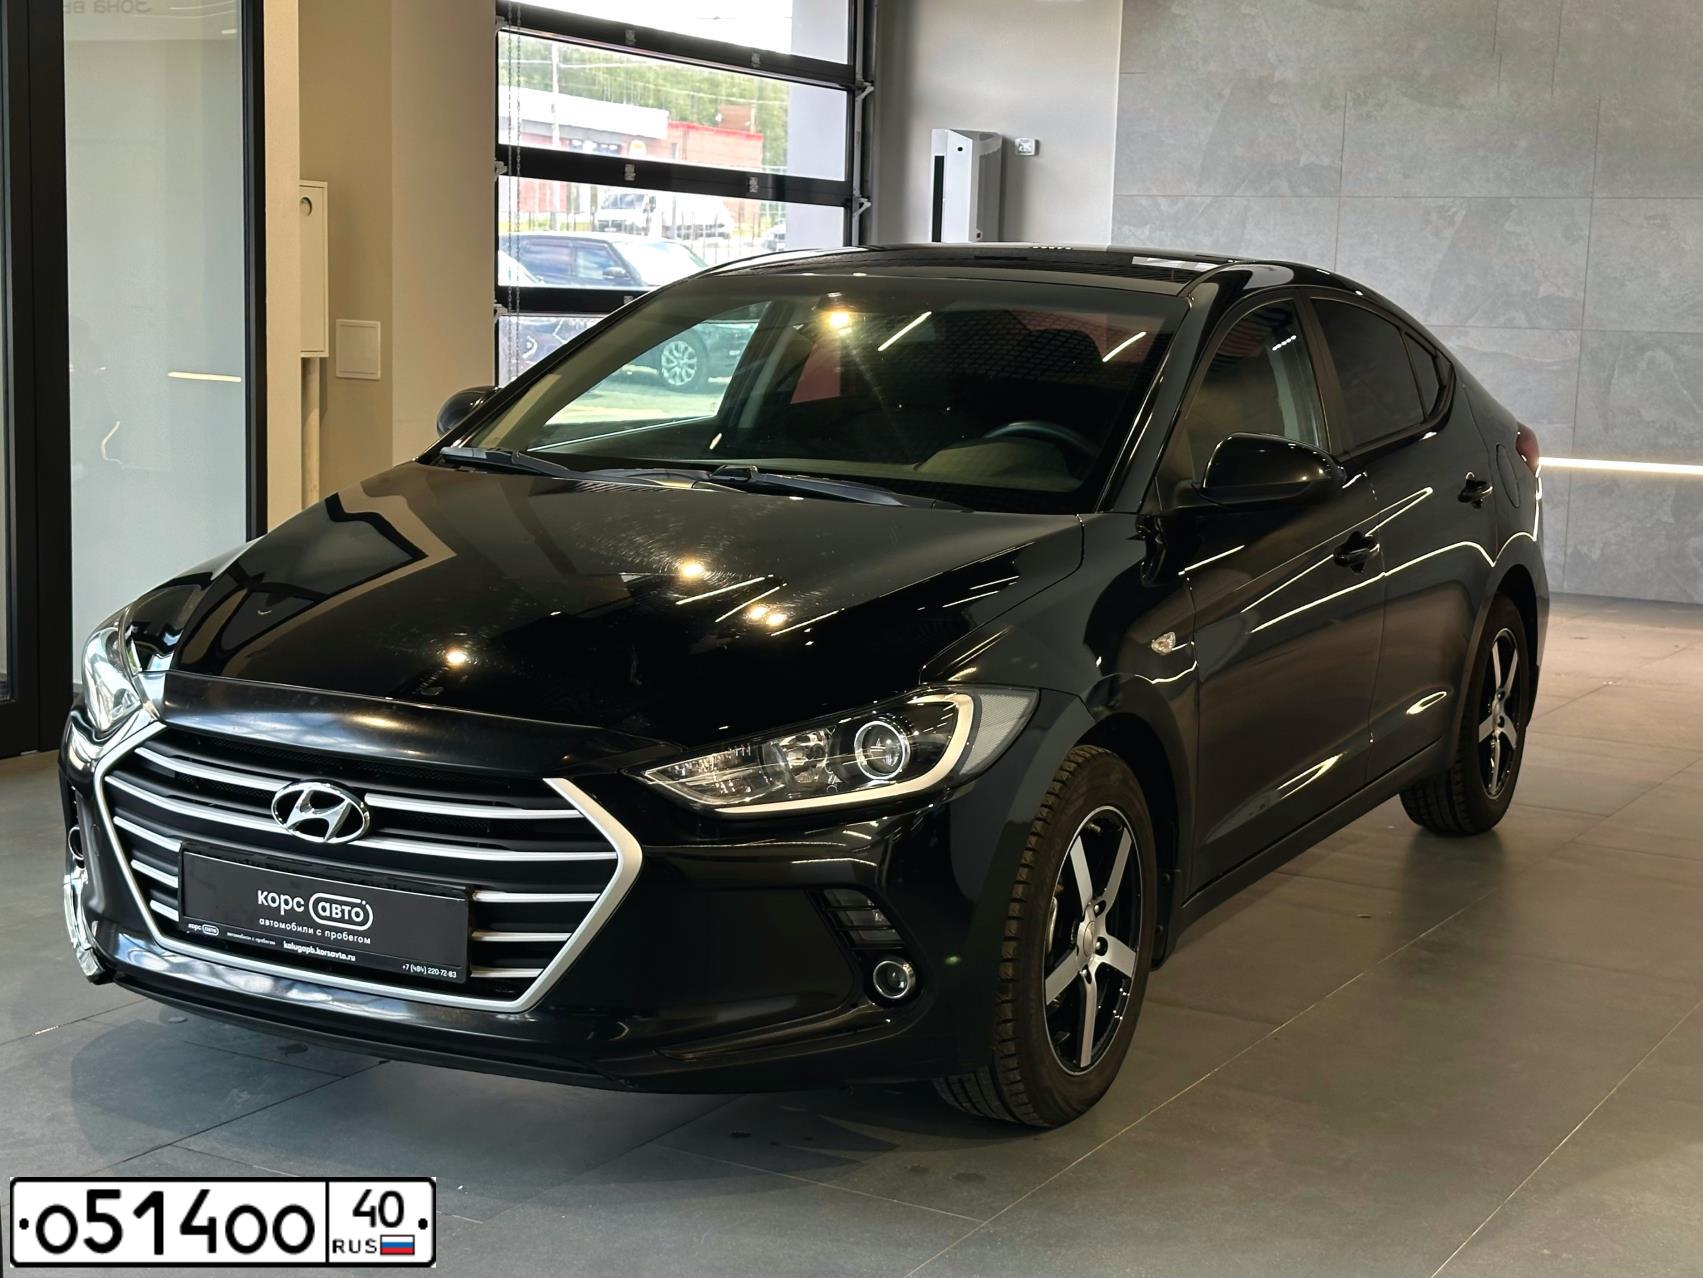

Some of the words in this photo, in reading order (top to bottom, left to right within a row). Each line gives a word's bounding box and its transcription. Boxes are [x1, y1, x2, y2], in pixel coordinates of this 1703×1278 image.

[257, 890, 304, 915] корс
[317, 901, 364, 922] авто
[259, 918, 314, 934] автомобили
[325, 931, 371, 945] пробегом
